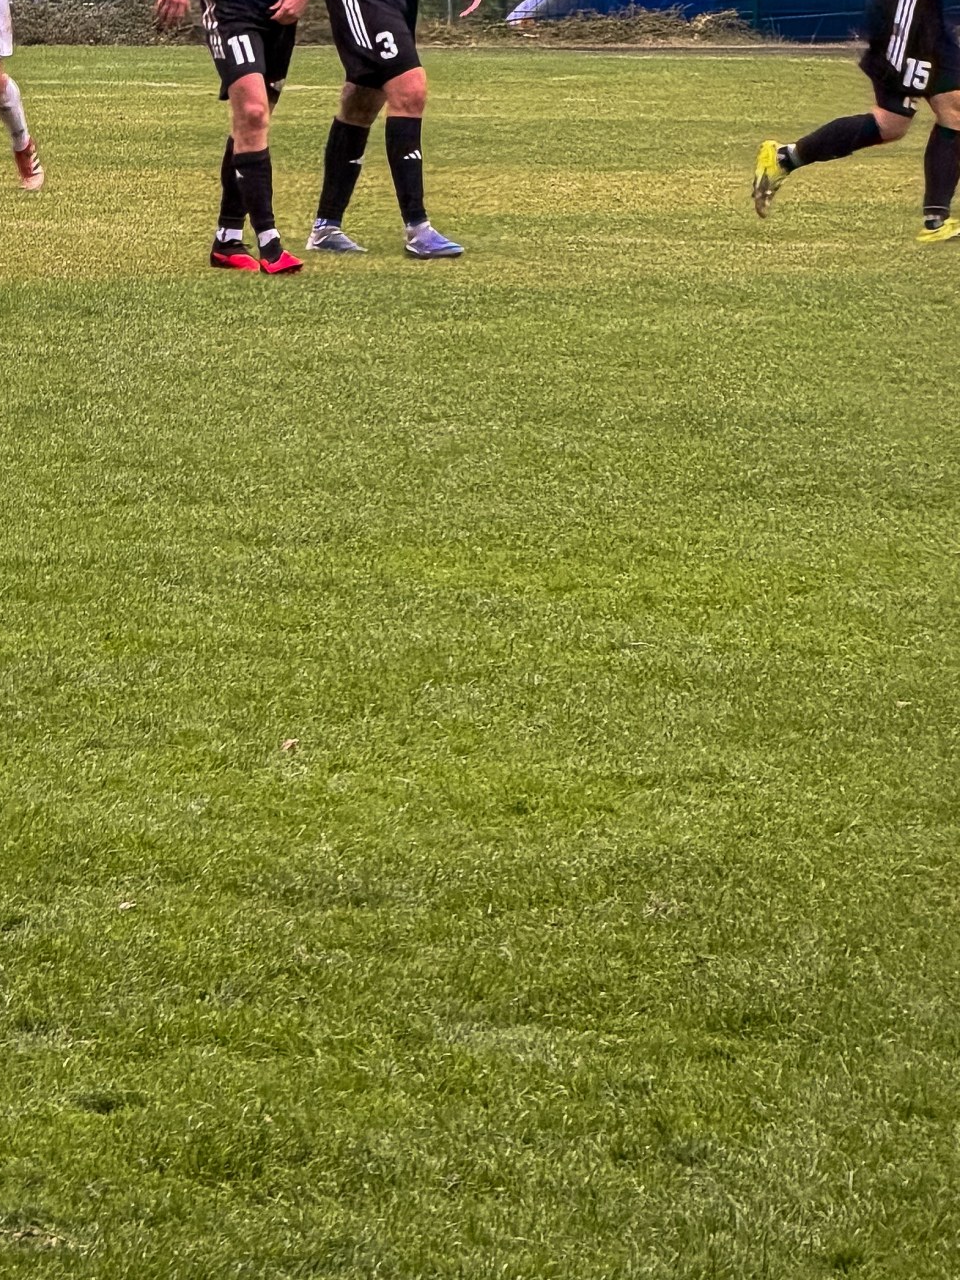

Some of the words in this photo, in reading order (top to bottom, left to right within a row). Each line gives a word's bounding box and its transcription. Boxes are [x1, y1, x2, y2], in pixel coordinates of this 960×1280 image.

[227, 34, 256, 66] 11
[375, 30, 399, 60] 3
[902, 57, 932, 90] 15
